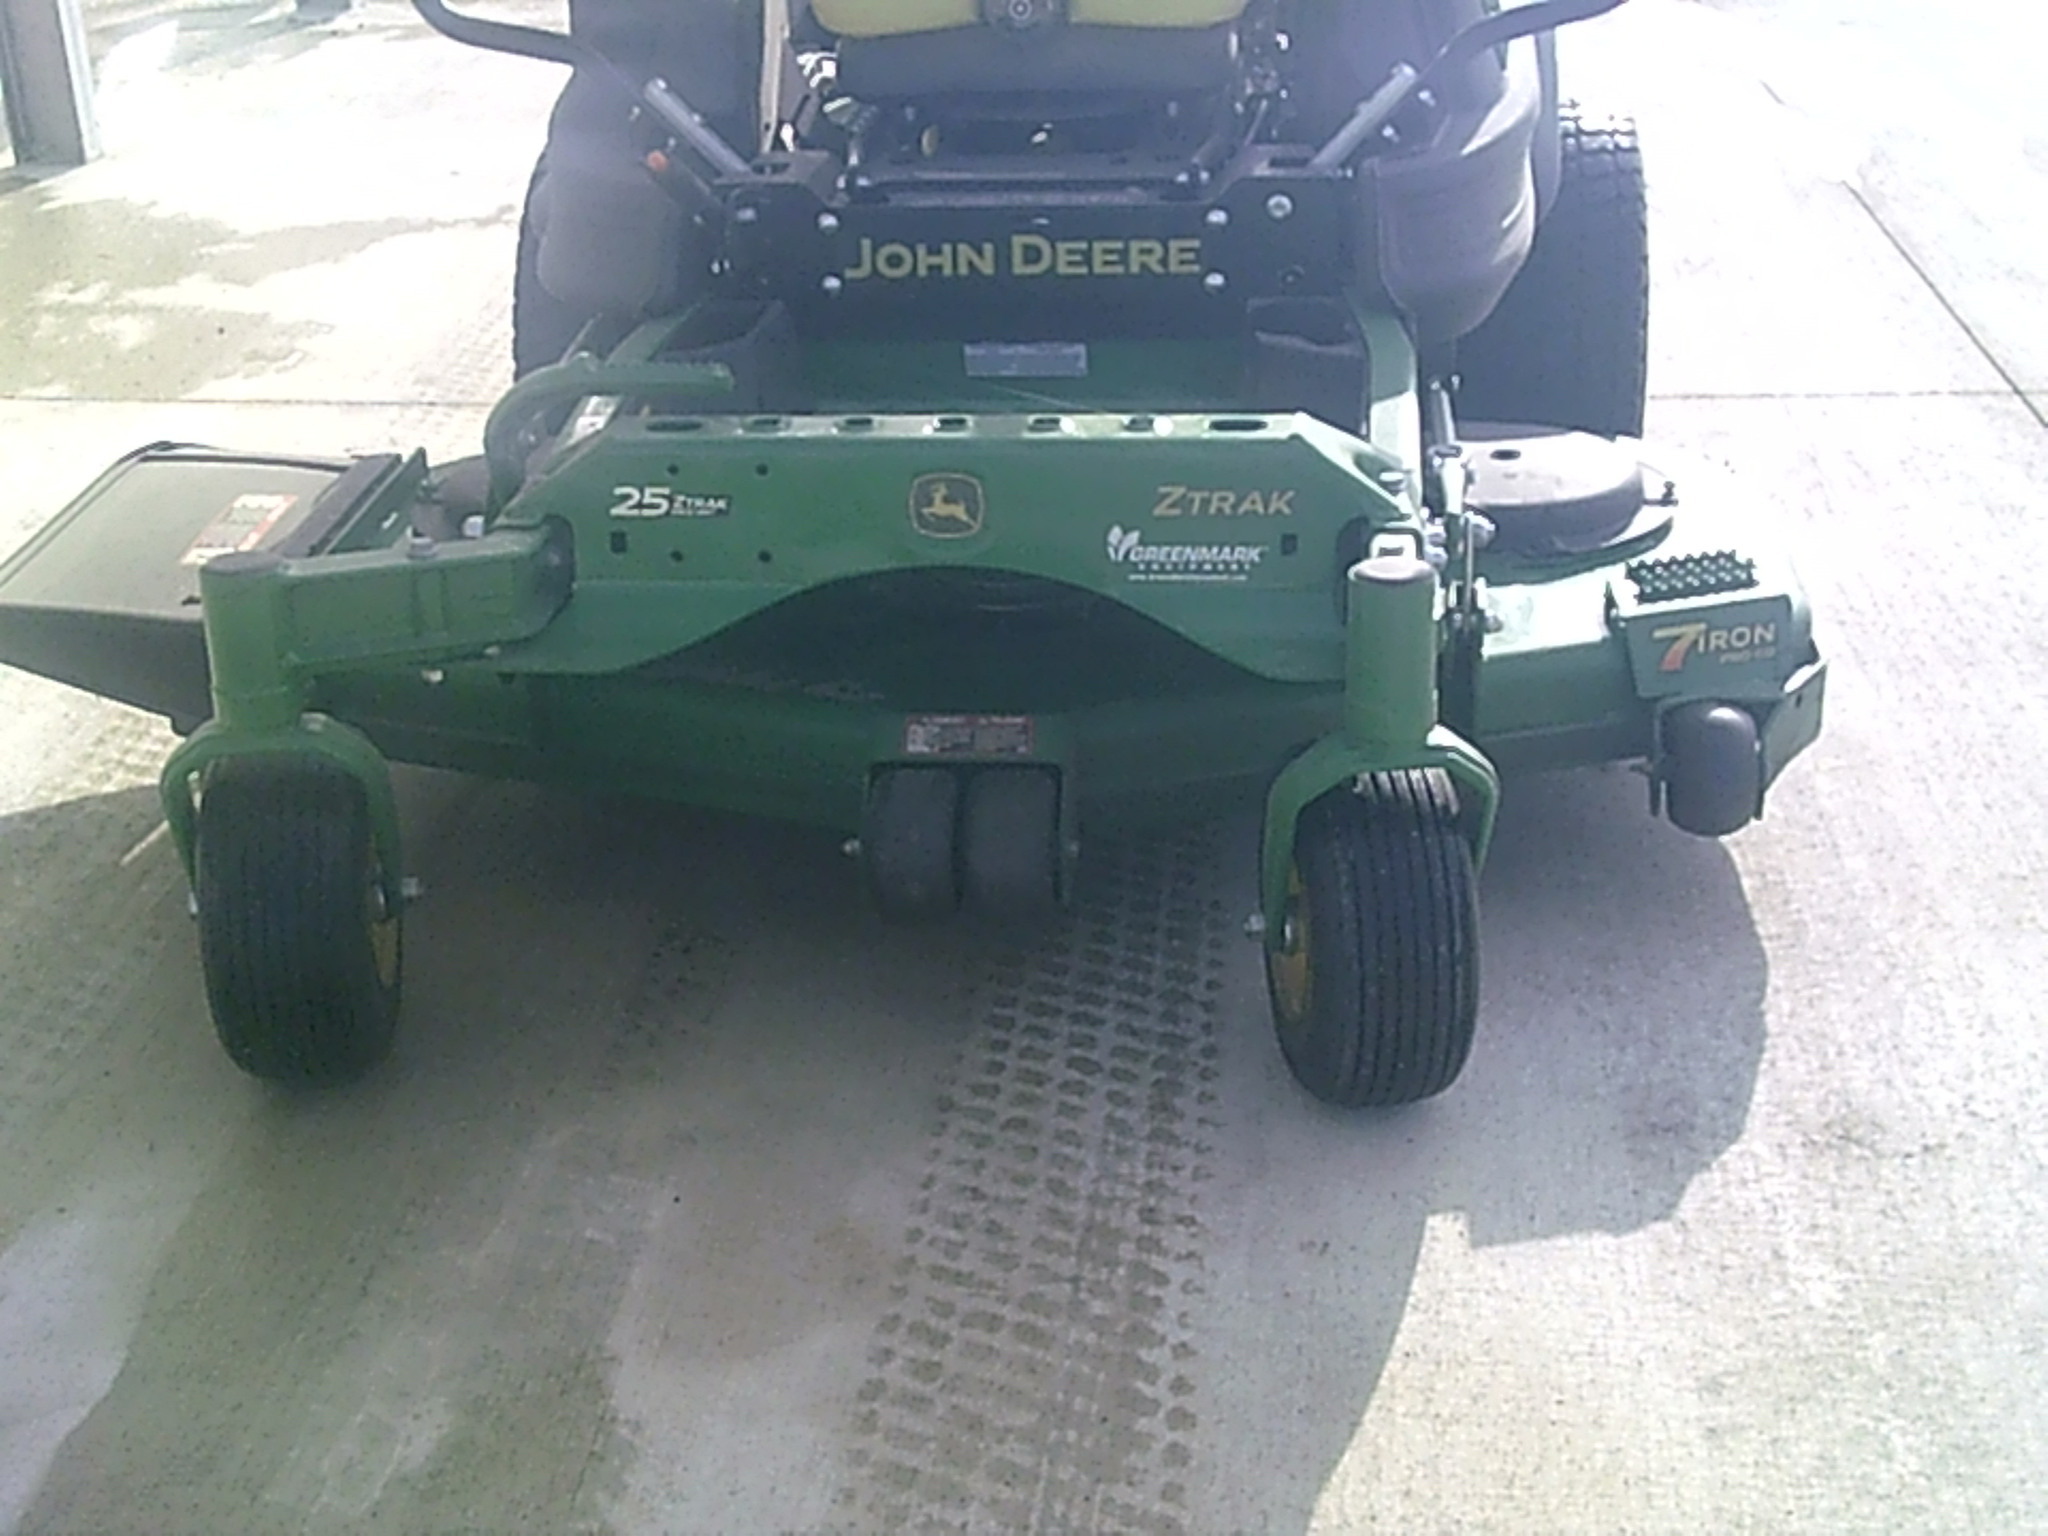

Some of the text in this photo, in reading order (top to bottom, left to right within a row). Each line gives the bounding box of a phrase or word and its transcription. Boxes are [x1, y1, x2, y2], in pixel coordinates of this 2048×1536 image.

[845, 234, 1200, 279] JOHN DEERE
[610, 486, 670, 516] 25
[1152, 486, 1296, 516] ZTRAK
[1129, 546, 1261, 562] GREENMARK
